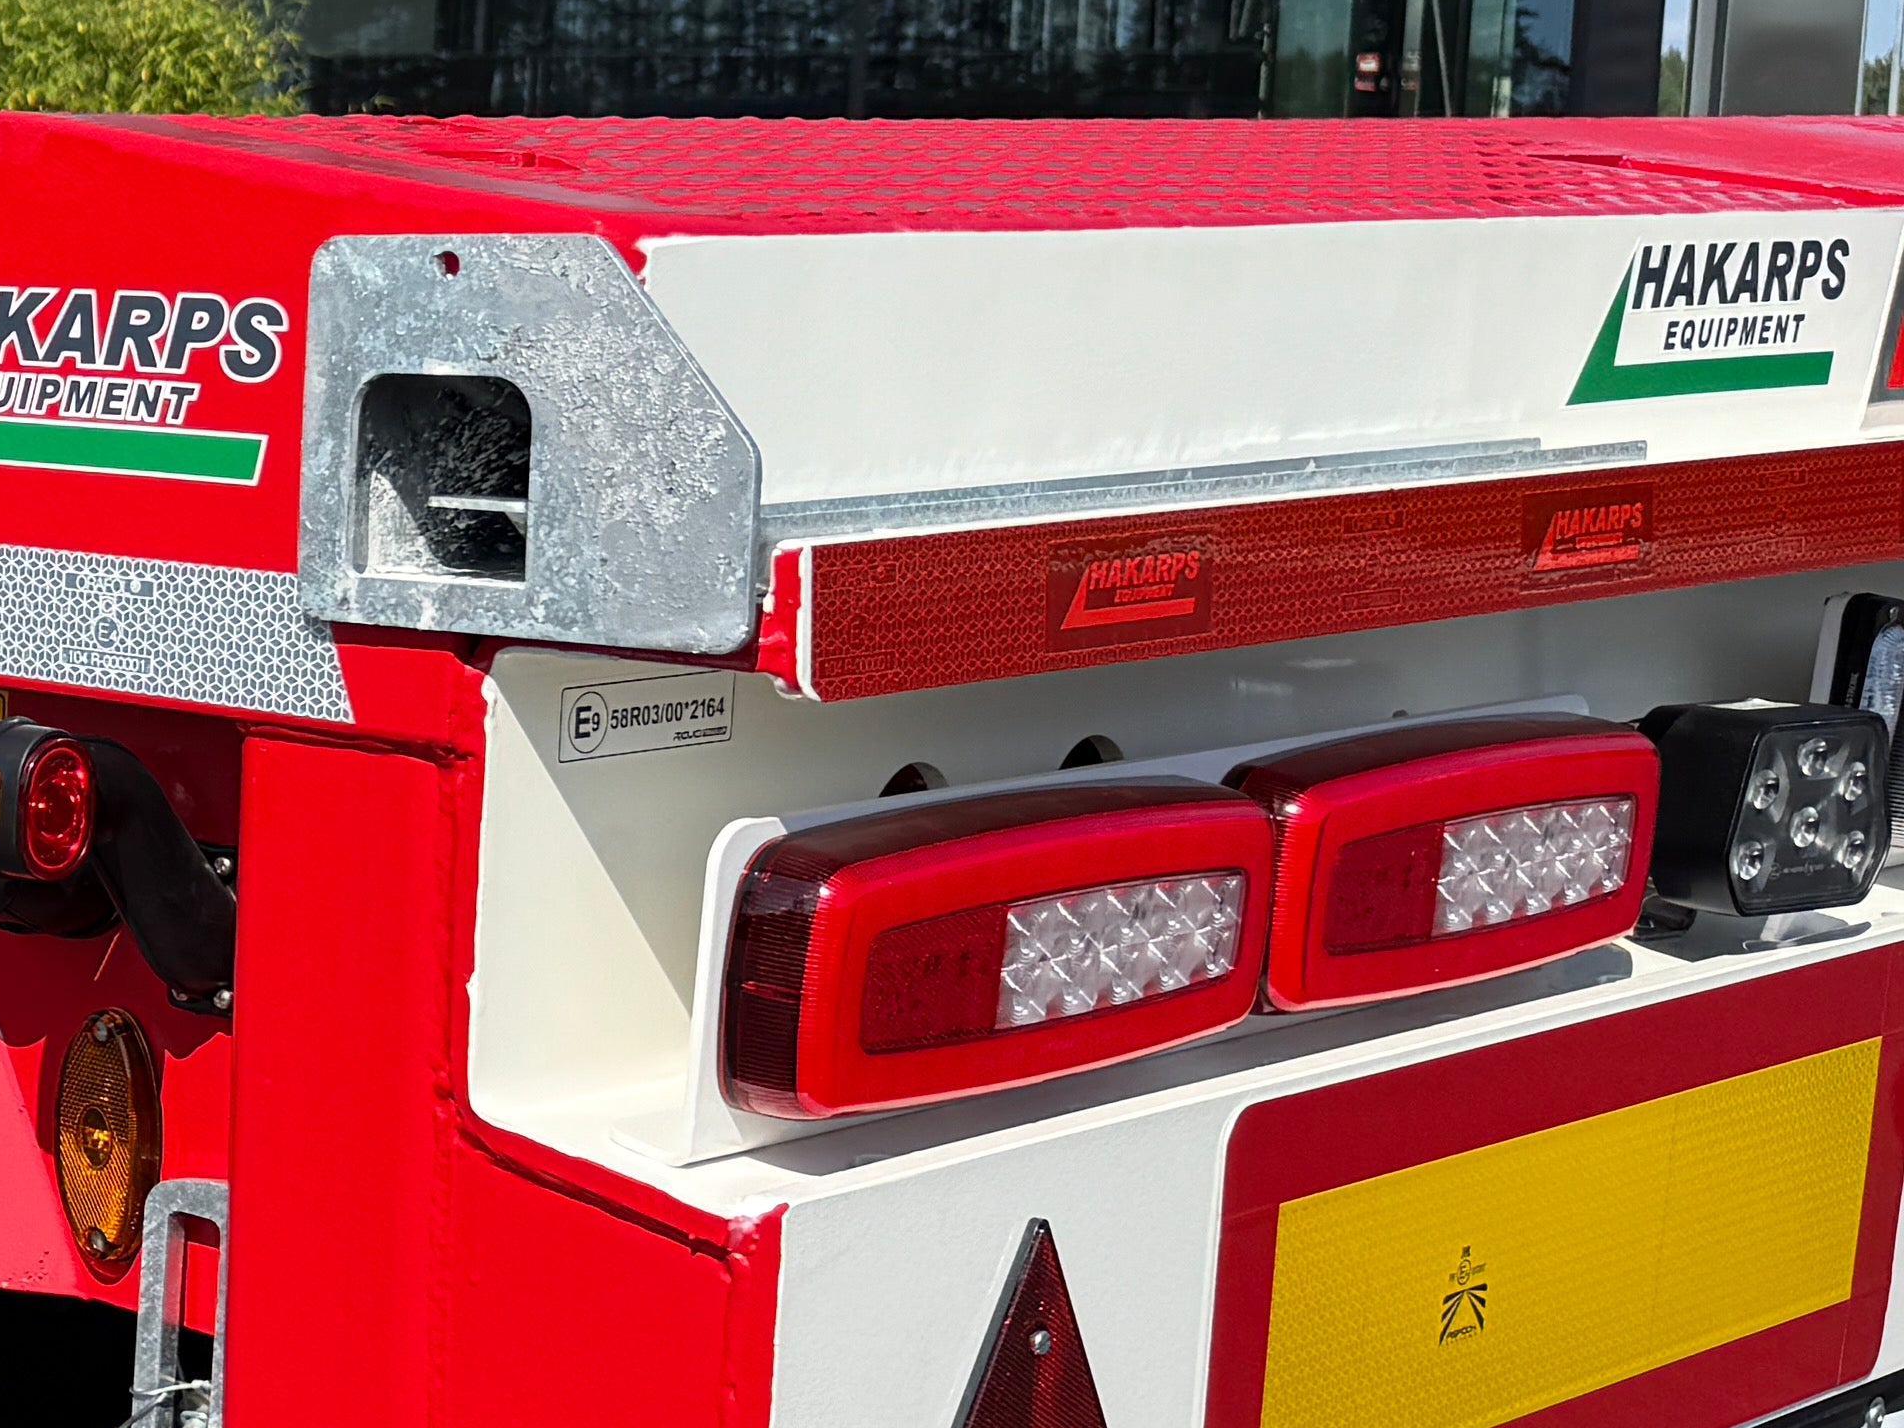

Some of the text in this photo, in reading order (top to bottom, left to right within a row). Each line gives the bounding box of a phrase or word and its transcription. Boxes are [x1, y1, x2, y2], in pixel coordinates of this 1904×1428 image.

[1632, 238, 1849, 310] HAKARPS
[1663, 314, 1805, 351] EQUIPMENT
[1556, 502, 1644, 540] HAKARPS
[1090, 550, 1201, 590] HAKARPS
